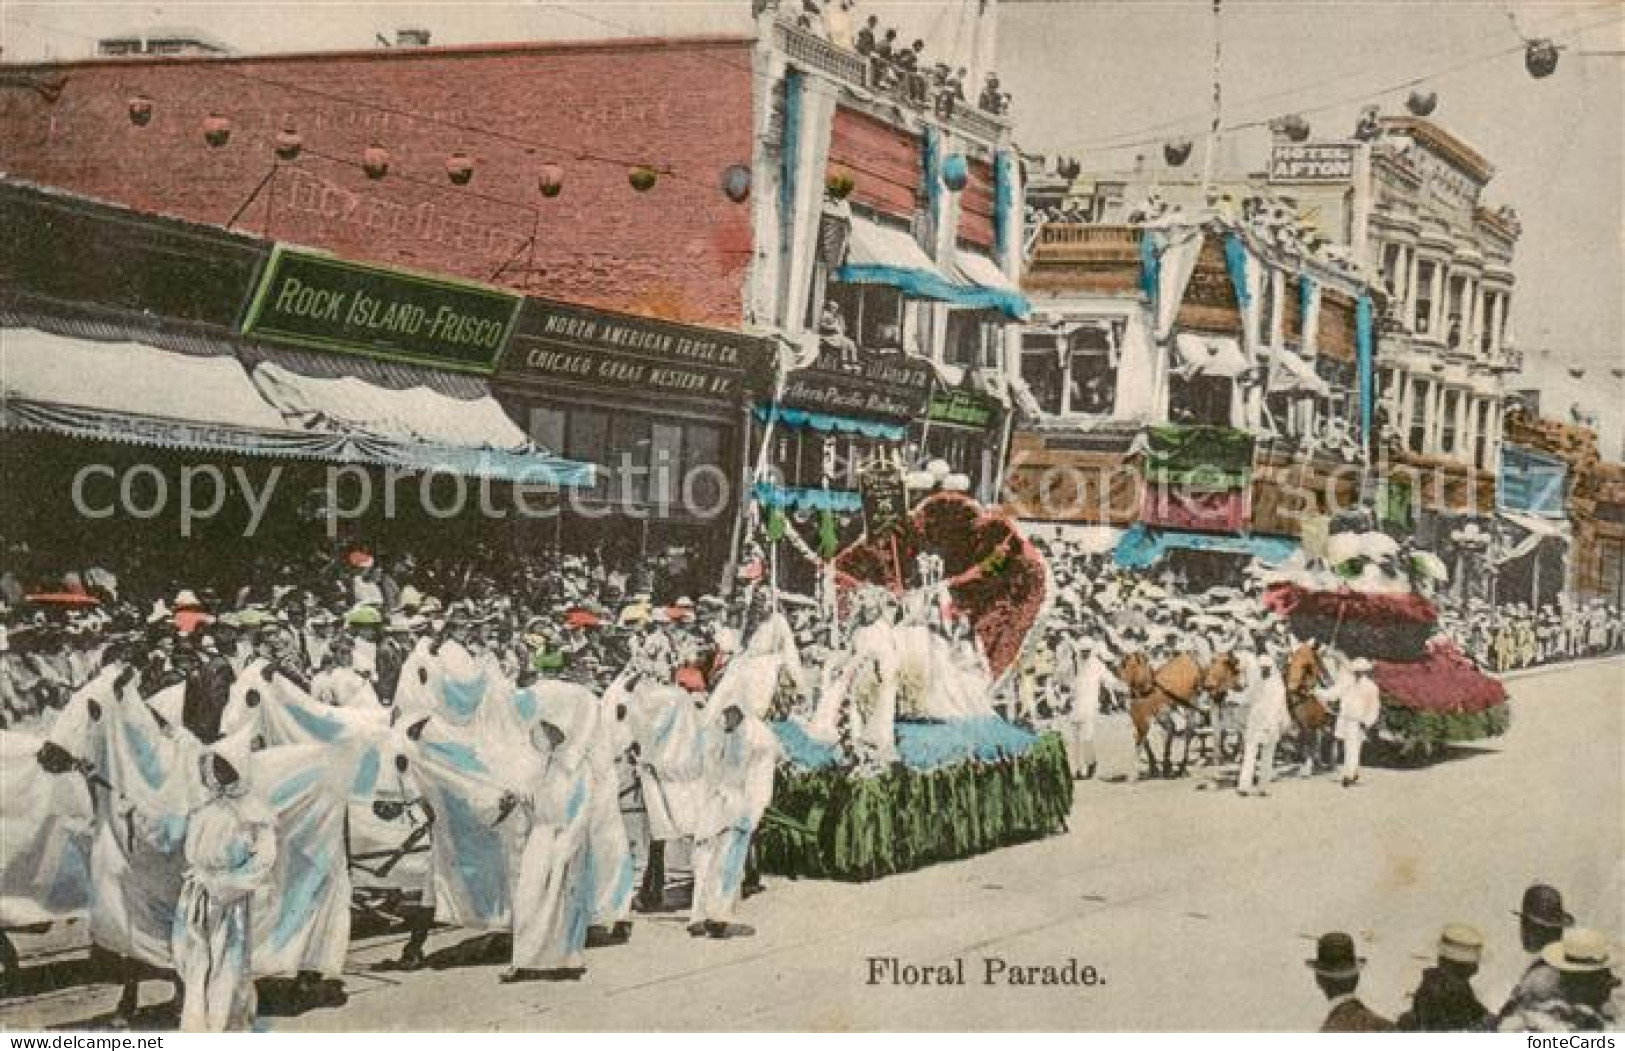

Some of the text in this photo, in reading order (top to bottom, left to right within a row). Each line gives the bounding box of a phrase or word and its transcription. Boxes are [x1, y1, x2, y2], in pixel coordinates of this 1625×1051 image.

[1275, 147, 1350, 159] HOTEL
[1274, 161, 1350, 176] AFTON
[275, 278, 344, 321] ROCK
[545, 315, 595, 339] NORTH
[602, 325, 673, 351] AMERICAN
[526, 348, 591, 375] CHICAGO
